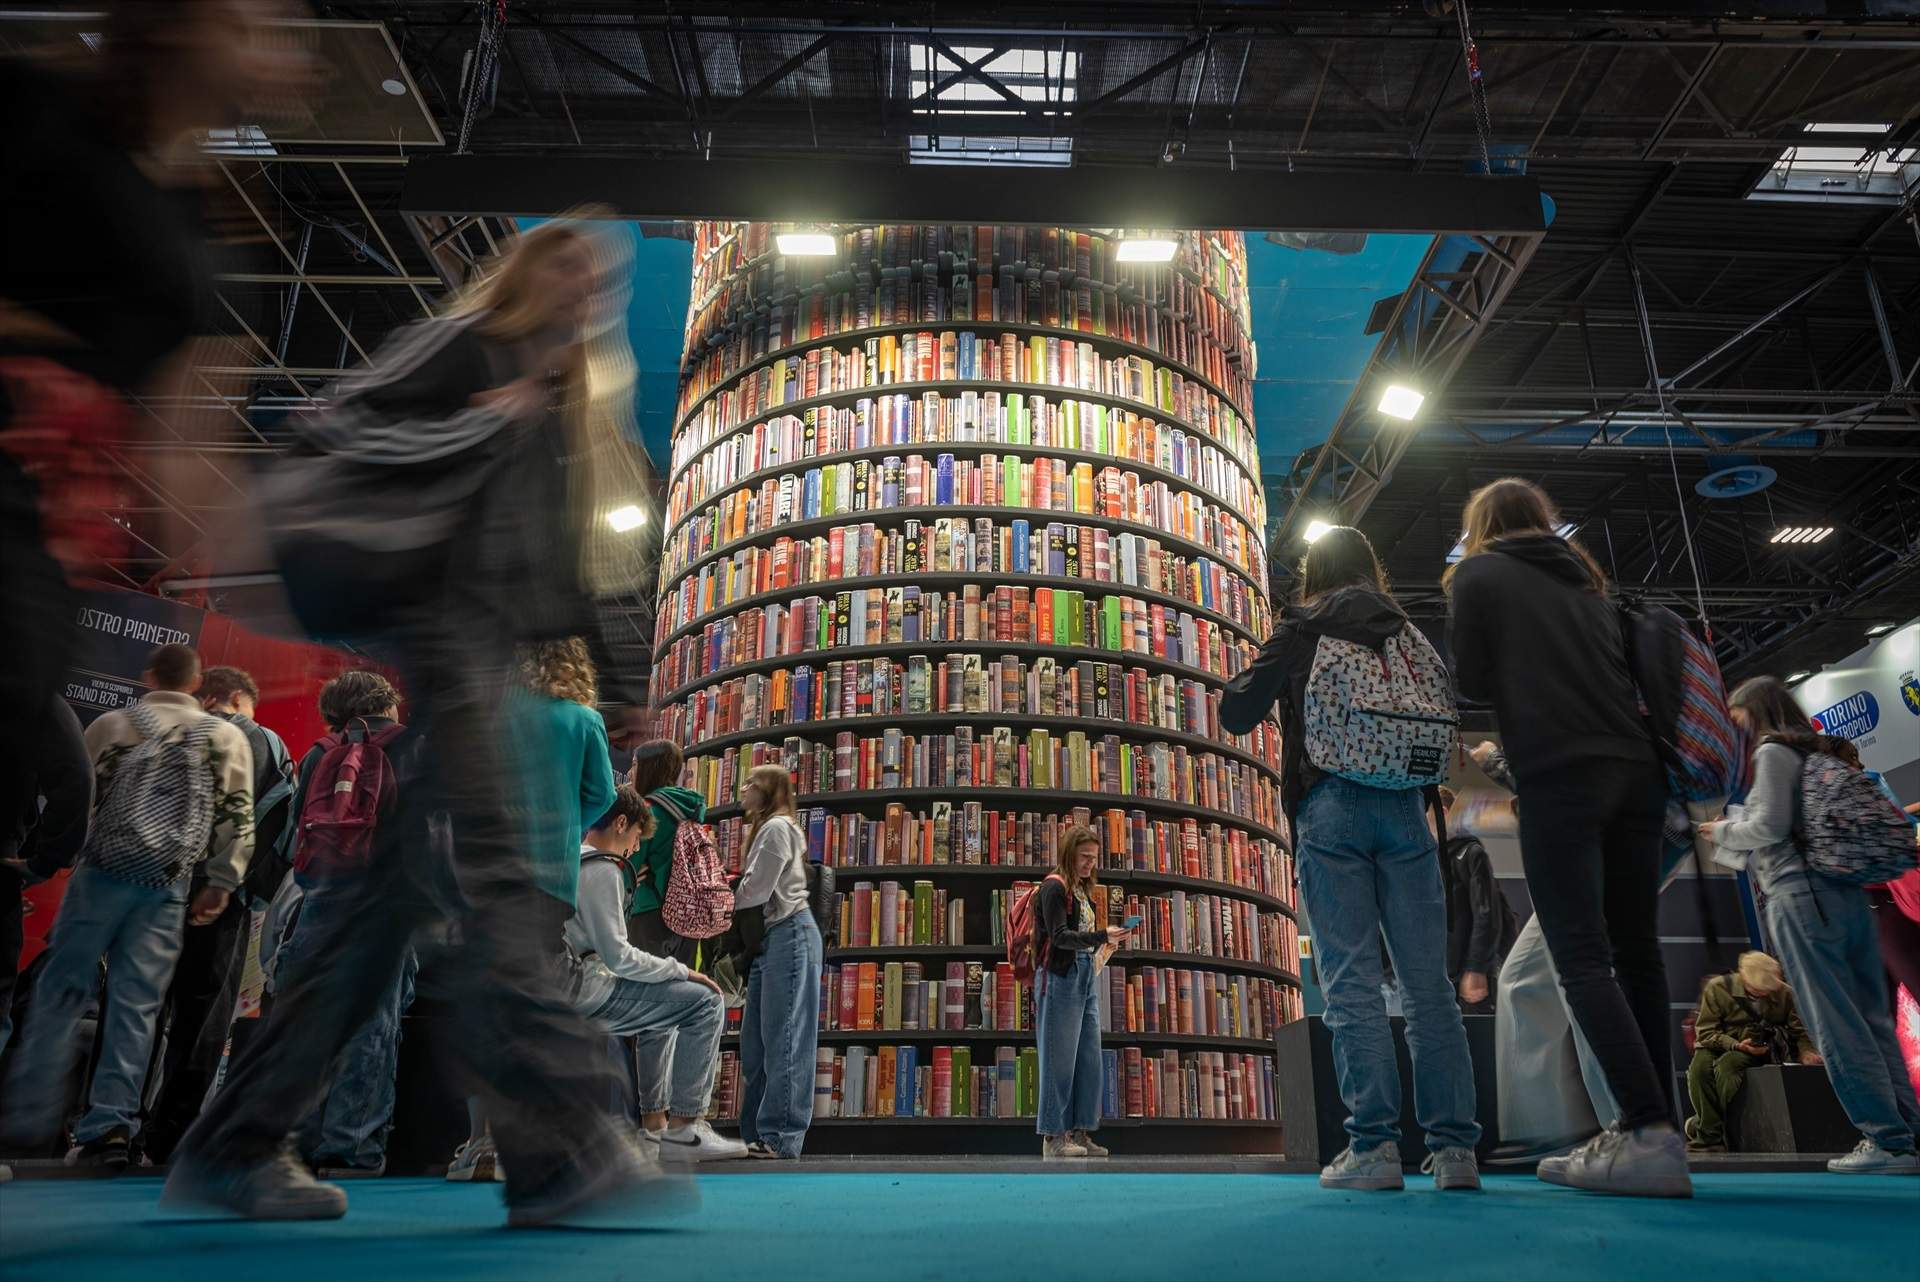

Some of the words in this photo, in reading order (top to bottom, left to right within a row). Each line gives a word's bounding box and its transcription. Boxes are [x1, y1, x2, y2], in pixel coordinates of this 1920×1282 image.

[66, 683, 98, 703] STAND
[99, 691, 119, 707] B78
[1822, 693, 1867, 730] TORINO
